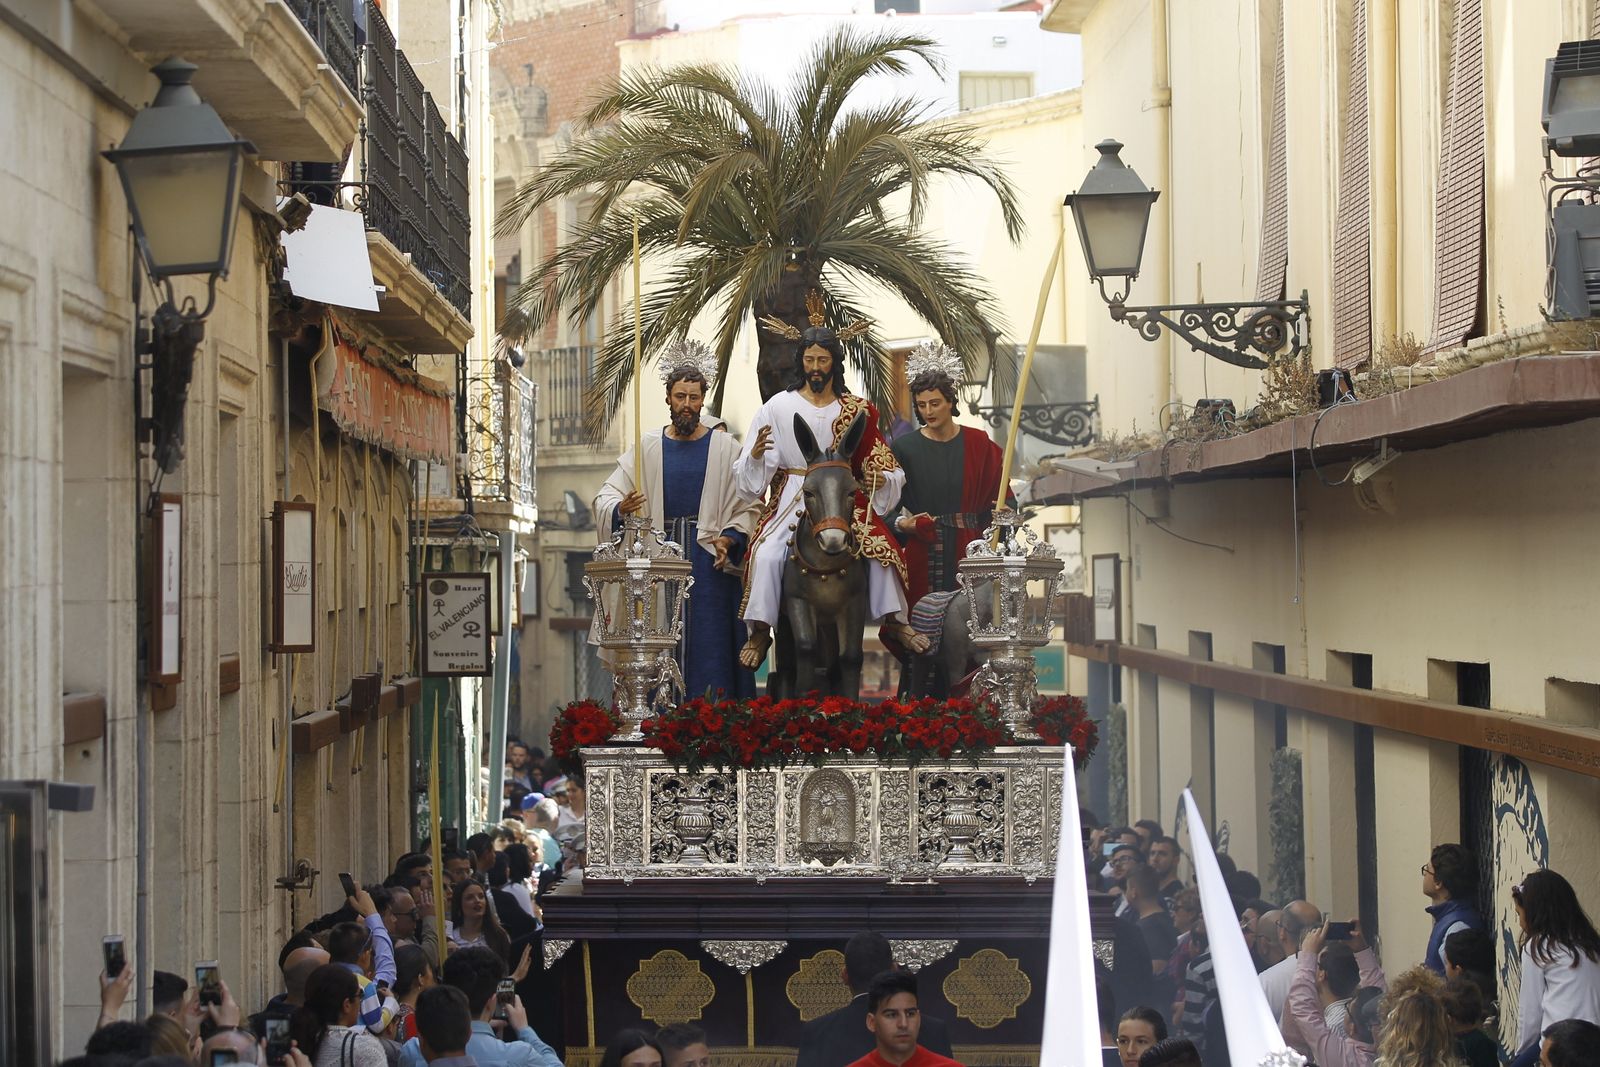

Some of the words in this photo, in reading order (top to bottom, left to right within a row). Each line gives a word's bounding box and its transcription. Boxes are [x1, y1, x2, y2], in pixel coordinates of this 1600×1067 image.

[429, 630, 441, 640] EL
[438, 593, 486, 632] VALENCIANO
[448, 662, 484, 671] Regalos
